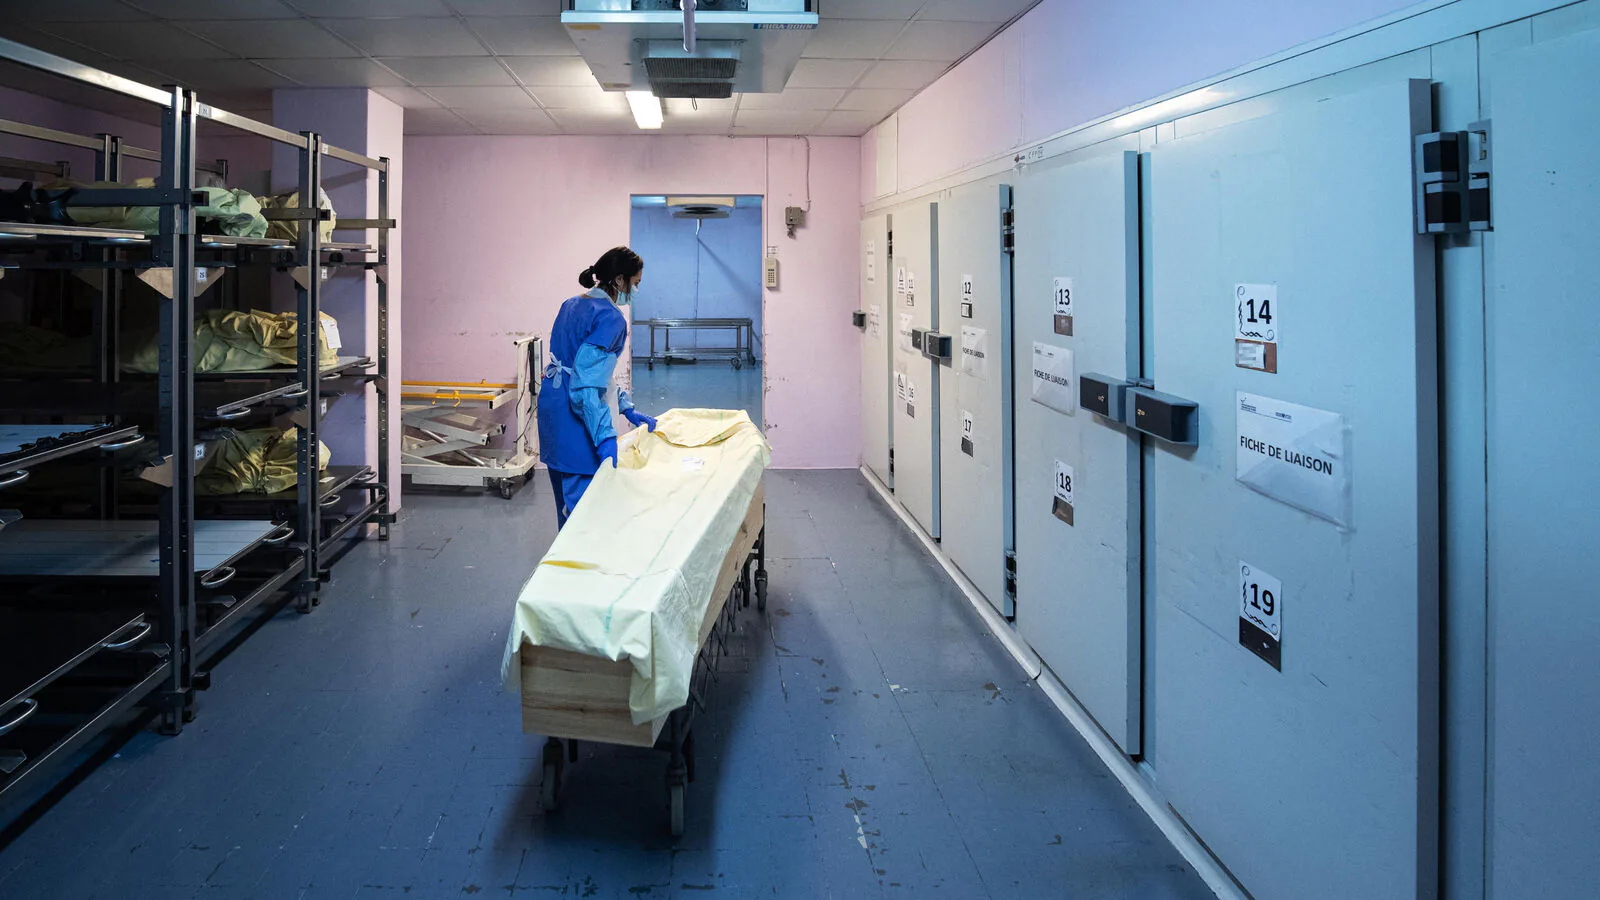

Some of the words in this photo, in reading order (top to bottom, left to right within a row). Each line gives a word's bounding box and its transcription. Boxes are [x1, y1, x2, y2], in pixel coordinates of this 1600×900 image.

[964, 281, 972, 295] 12
[1058, 288, 1071, 306] 13
[1246, 298, 1272, 325] 14
[1034, 368, 1045, 380] FICHE
[1044, 372, 1051, 382] DE
[1050, 374, 1069, 387] LIAISON
[964, 418, 972, 433] 17
[1240, 435, 1265, 455] FICHE
[1268, 444, 1282, 460] DE
[1284, 449, 1333, 476] LIAISON
[1059, 472, 1072, 493] 18
[1250, 583, 1275, 617] 19
